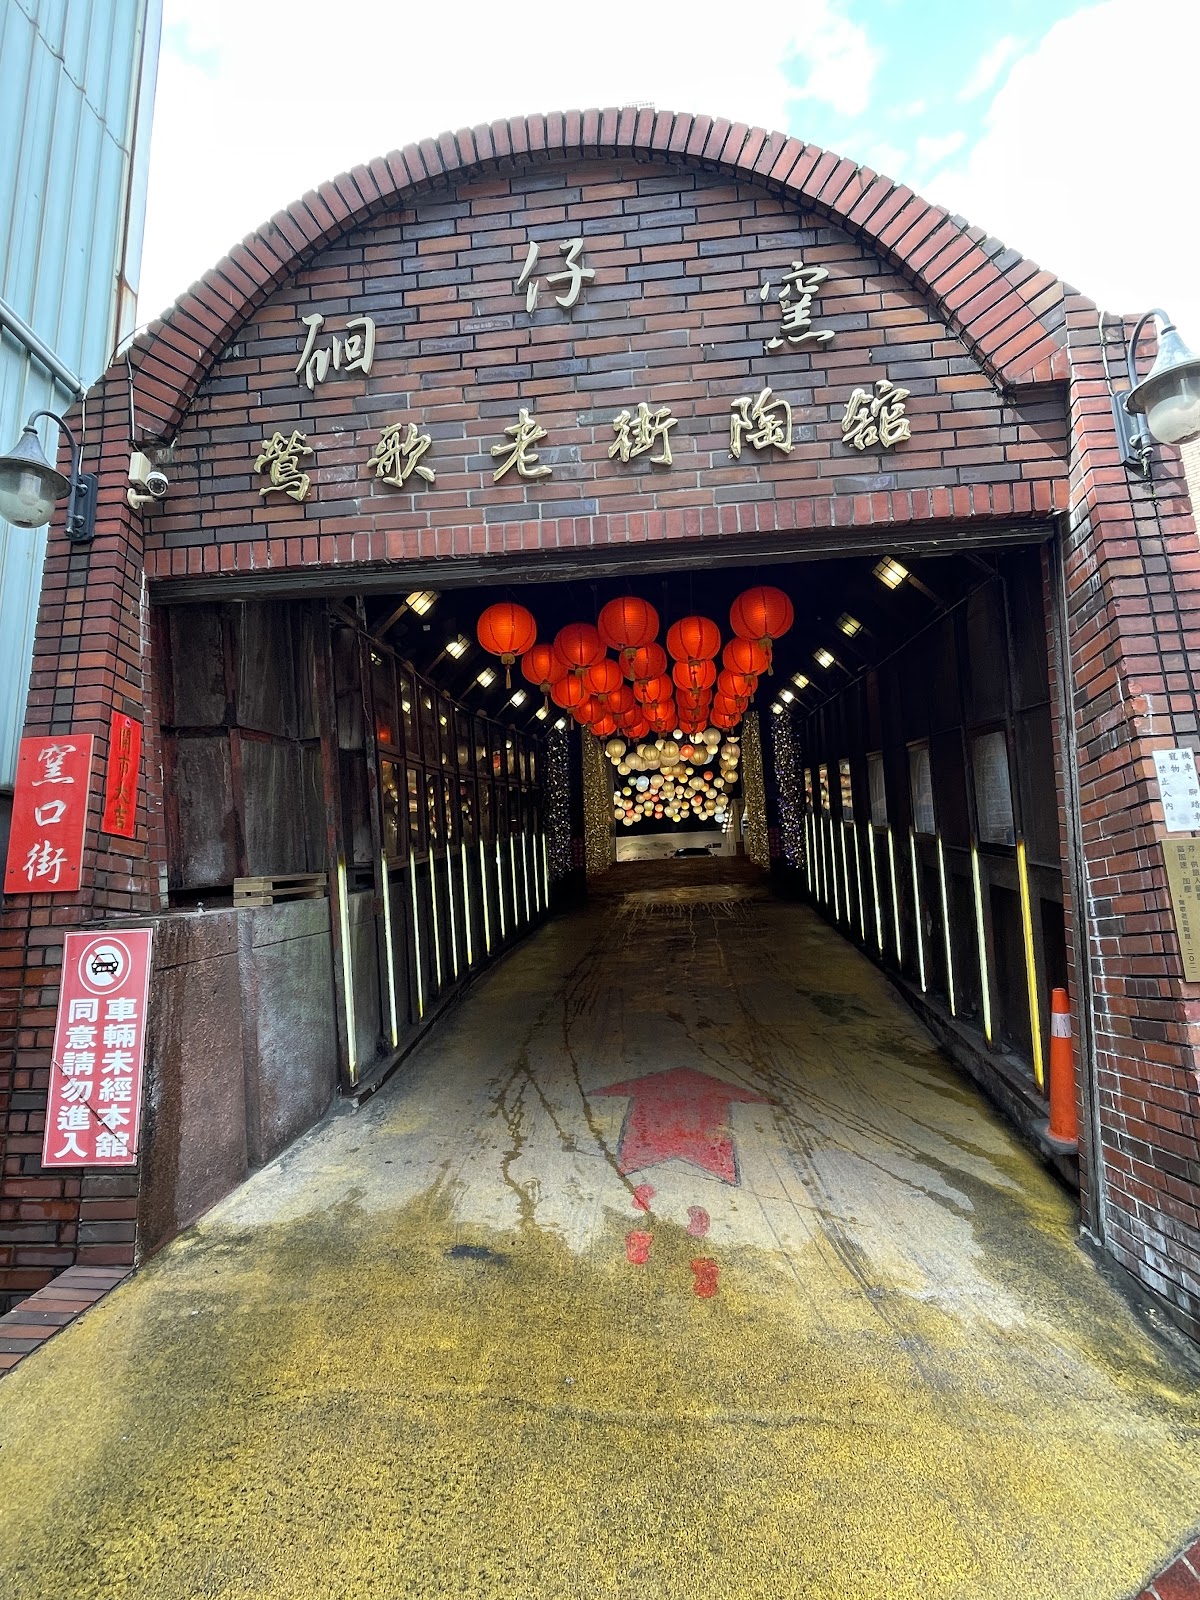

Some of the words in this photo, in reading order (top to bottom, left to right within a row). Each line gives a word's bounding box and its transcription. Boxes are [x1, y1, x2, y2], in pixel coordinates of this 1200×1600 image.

[53, 998, 99, 1159] 同意請勿進入
